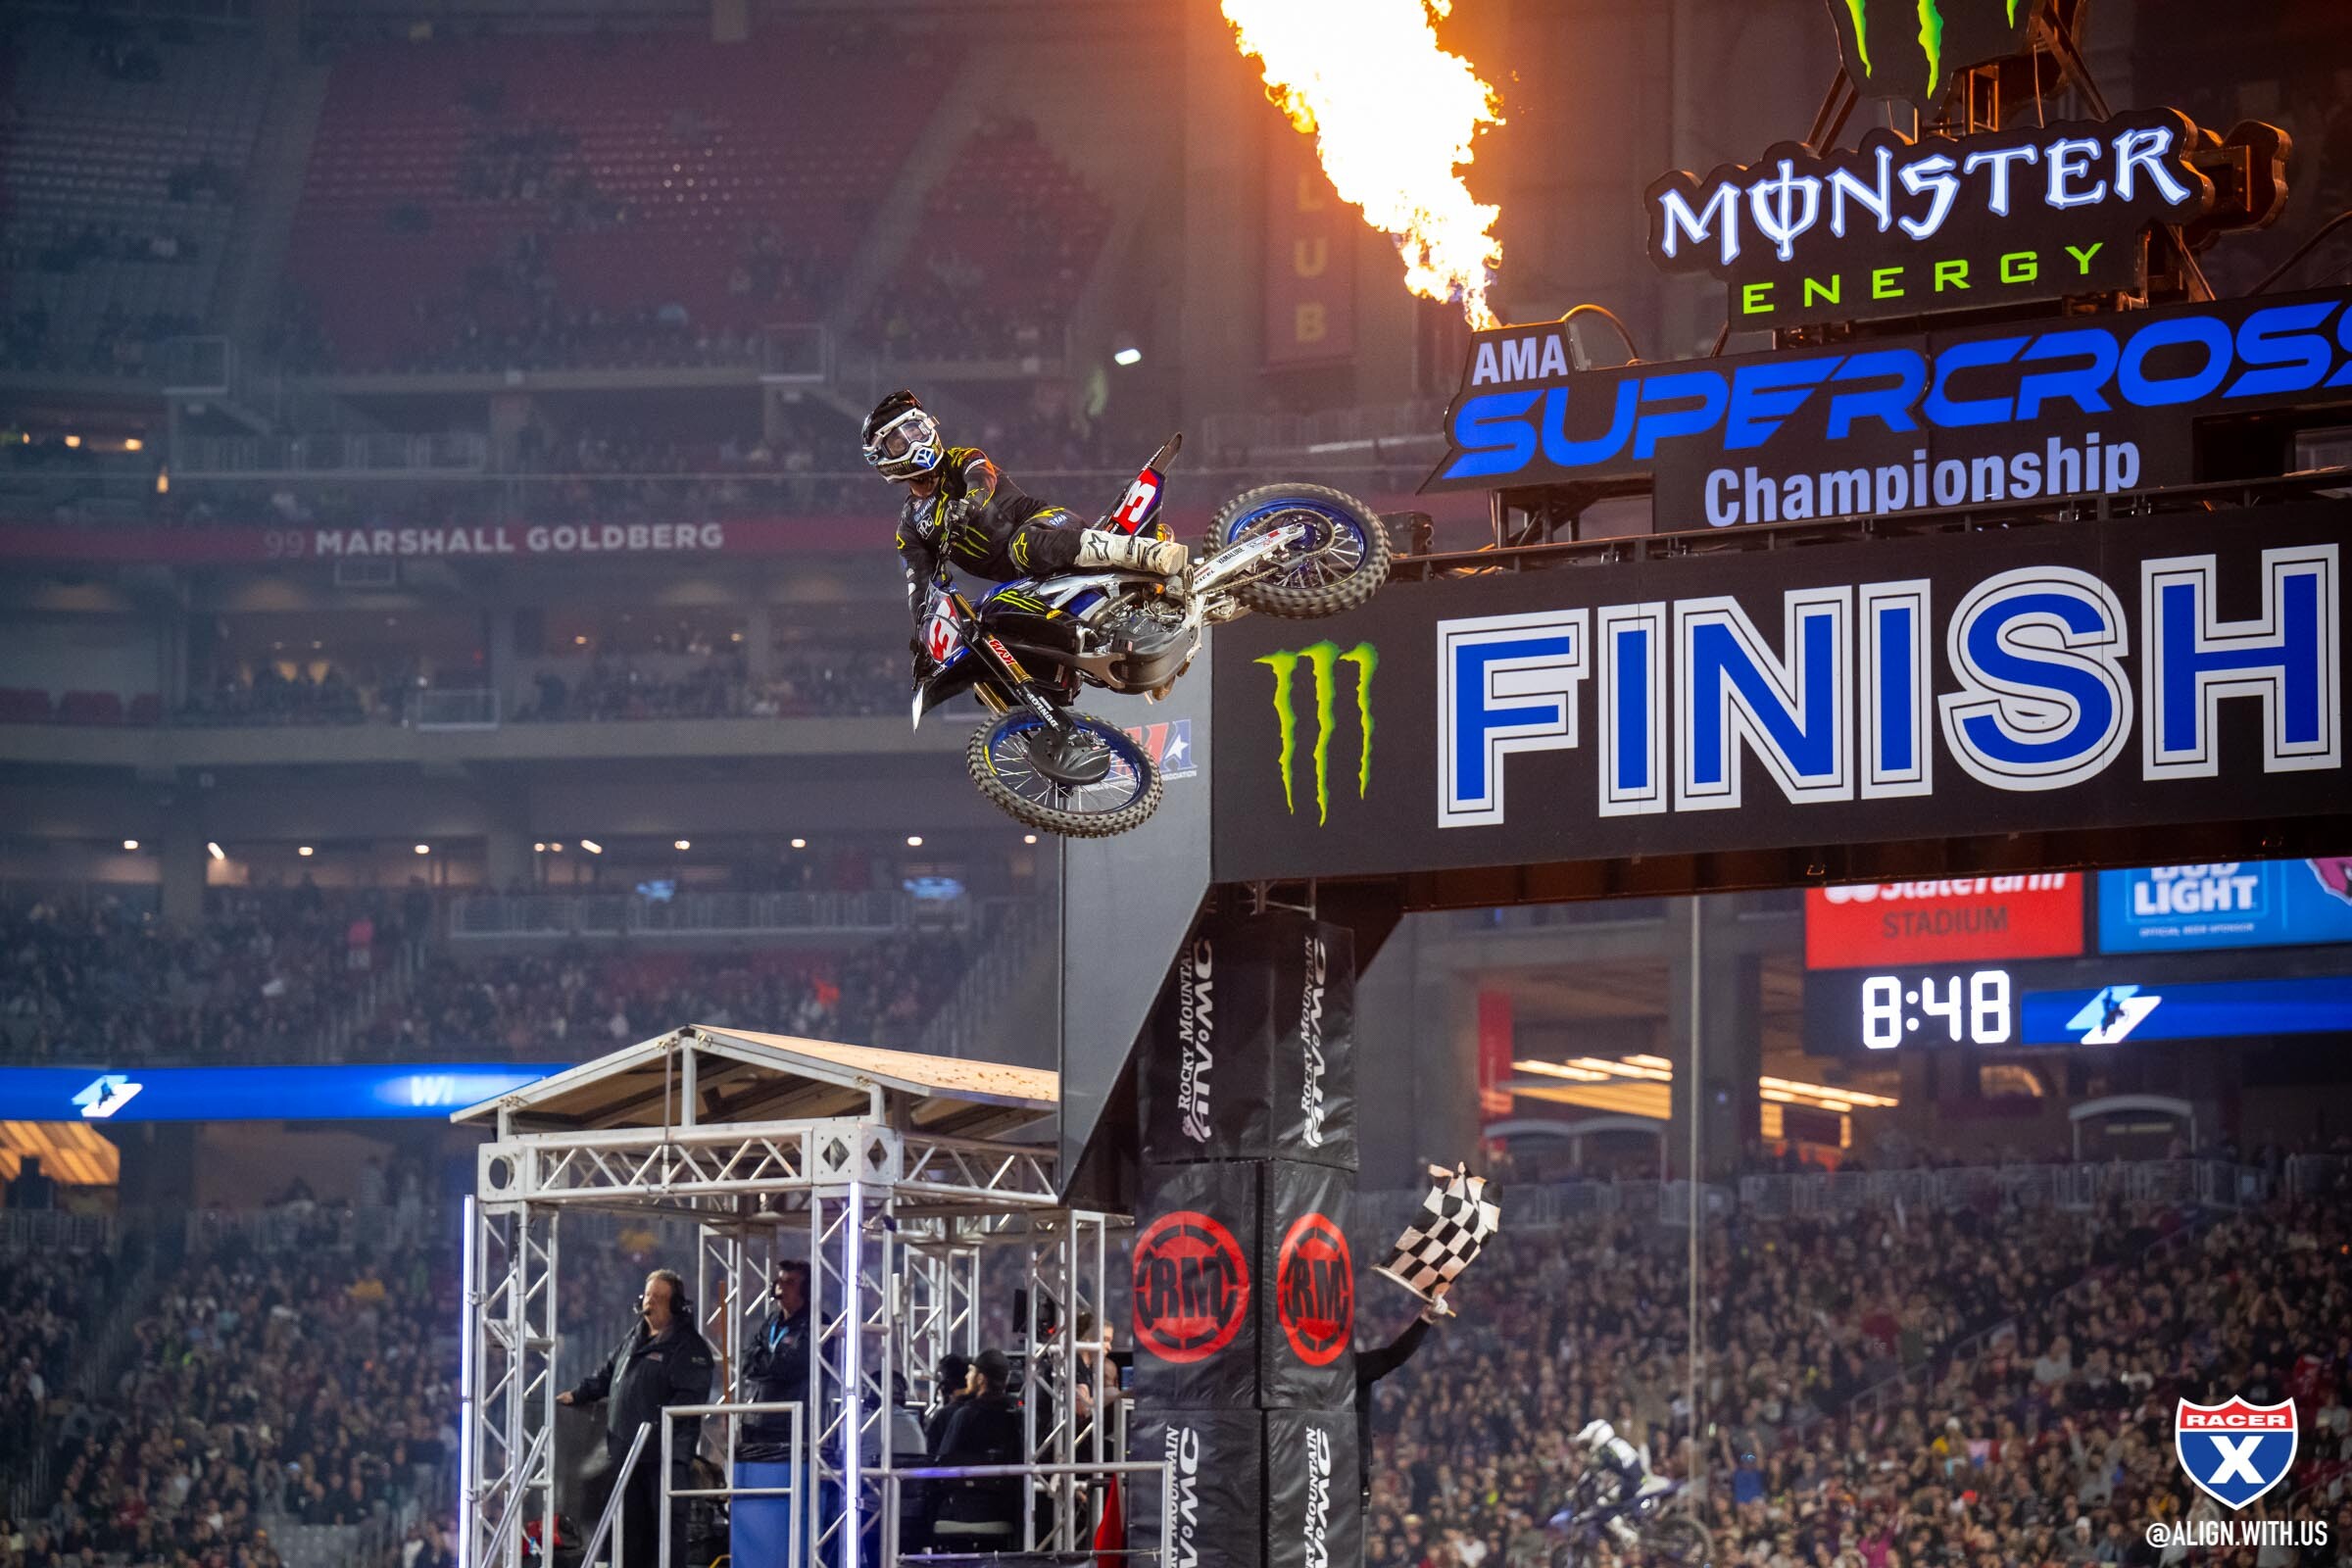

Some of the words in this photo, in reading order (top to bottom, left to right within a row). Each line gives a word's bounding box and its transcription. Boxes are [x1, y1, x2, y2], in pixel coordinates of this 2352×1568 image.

[1659, 126, 2191, 266] MONSTER
[1742, 242, 2104, 315] ENERGY
[1443, 298, 2352, 480] SUPERCROS
[1472, 333, 1568, 385] AMA
[1705, 431, 2141, 528] Championship
[316, 527, 514, 557] MARSHALL
[527, 523, 724, 552] GOLDBERG
[1026, 692, 1059, 728] DUNLOP
[1438, 543, 2342, 828] FINISH
[1883, 906, 2009, 939] STADIUM
[2134, 875, 2258, 916] LIGHT
[1301, 936, 1314, 1045] MOUNTAIN
[1863, 969, 2011, 1050] 8:48
[1178, 1046, 1195, 1113] ROCKY
[1300, 1047, 1313, 1114] ROCKY
[1303, 1426, 1318, 1541] MOUNTAIN
